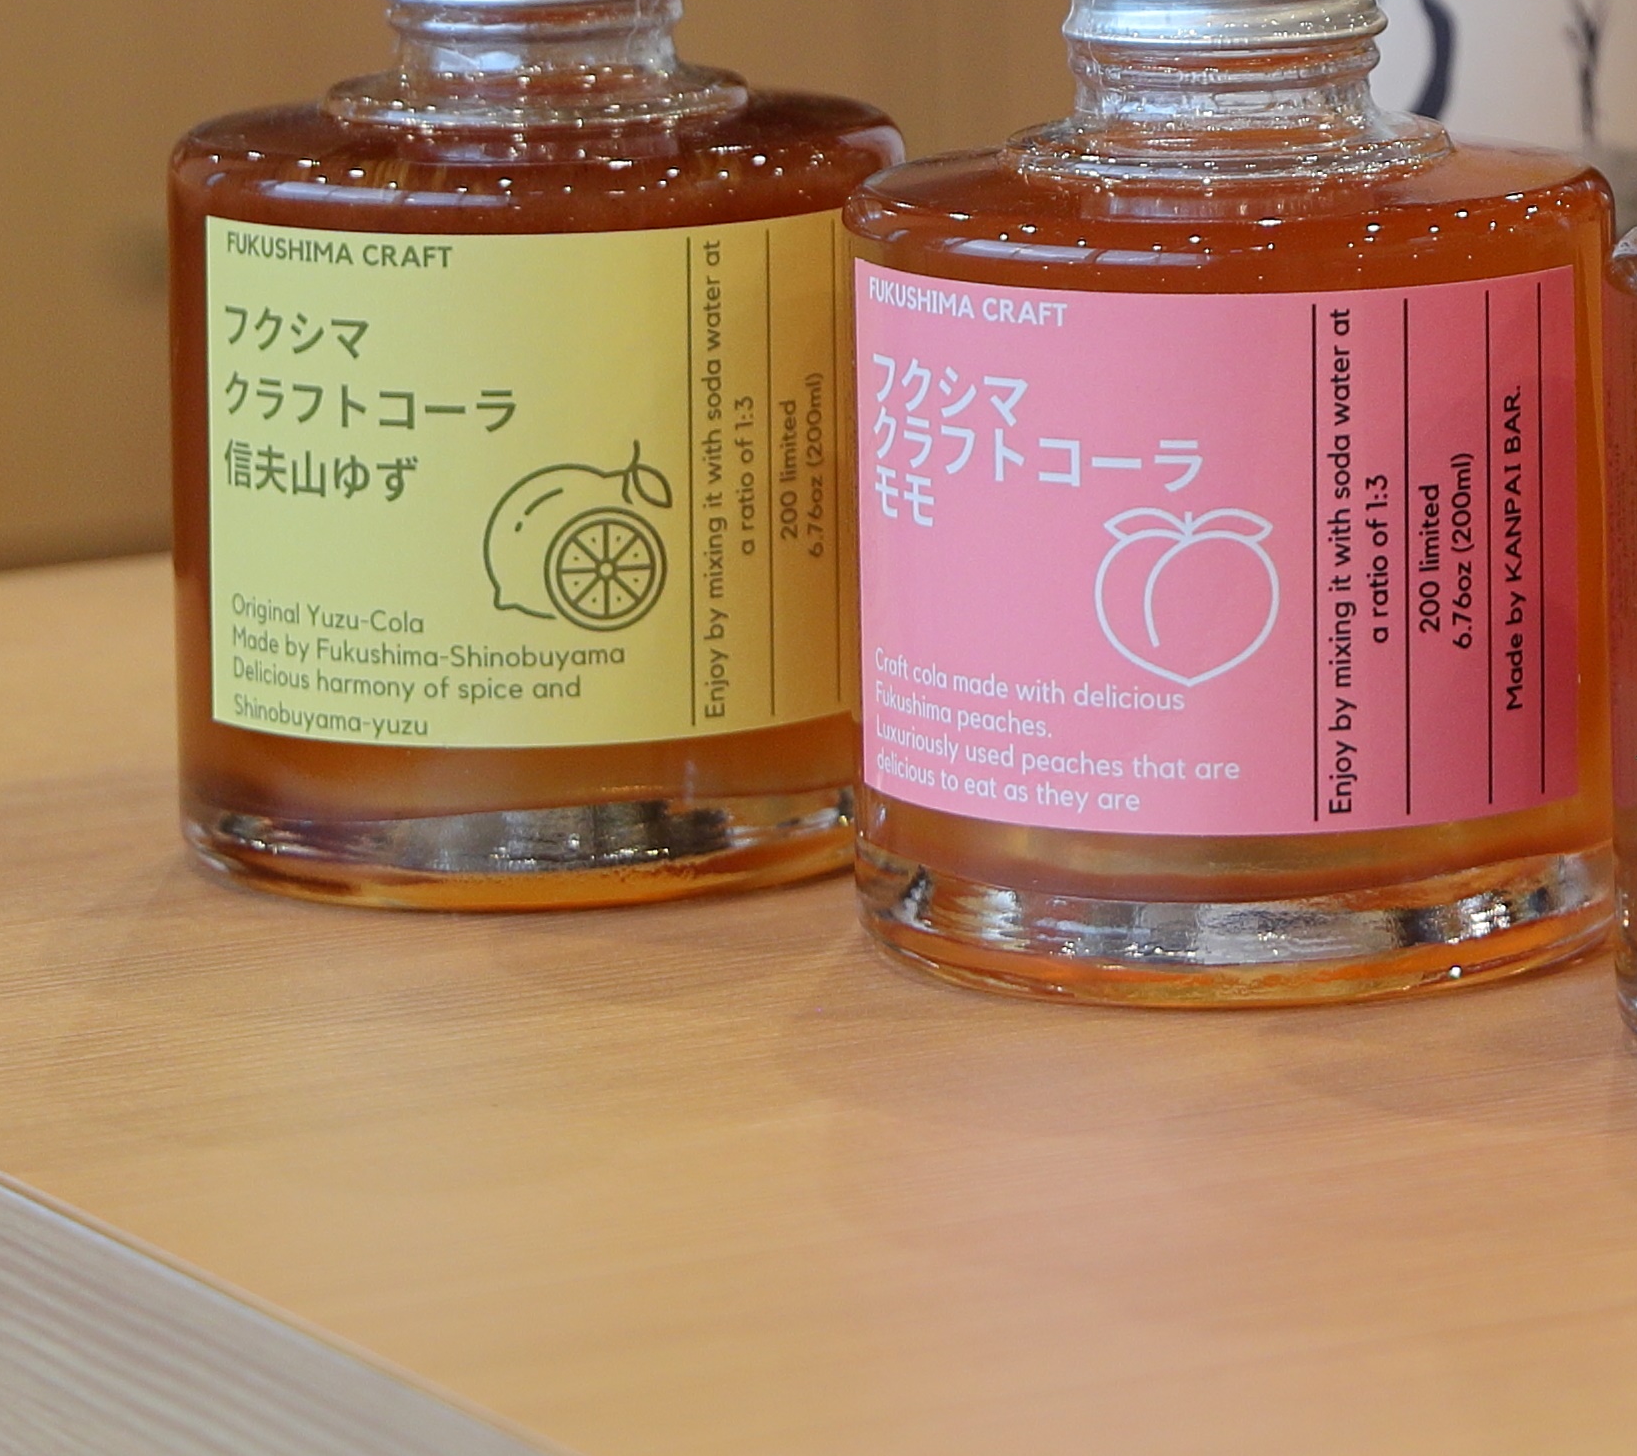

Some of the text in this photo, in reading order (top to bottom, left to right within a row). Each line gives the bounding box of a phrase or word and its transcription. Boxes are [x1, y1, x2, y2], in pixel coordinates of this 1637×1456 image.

[227, 231, 452, 268] FUKUSHIMA CRAFT
[225, 305, 369, 359] フクシマ
[869, 276, 1068, 327] FUKUSHIMA CRAFT
[225, 371, 516, 432] クラフトコーラ
[873, 353, 1028, 426] フクシマ
[224, 439, 419, 501] 信夫山ゆず
[701, 241, 729, 718] Enjoy by mixing it with soda water at
[735, 396, 755, 555] a ratio of 1:3
[780, 399, 798, 539] 200 limited
[805, 373, 824, 558] 6.76oz (200ml)
[873, 406, 1203, 492] クラフトコーラ
[875, 465, 934, 527] モモ
[1327, 309, 1357, 814] Enjoy by mixing it with soda water at
[1366, 475, 1388, 643] a ratio of 1:3
[1418, 484, 1440, 633] 200 limited
[1451, 453, 1474, 649] 6.76oz (200ml)
[1504, 386, 1526, 710] Made by KANPAI BAR.
[232, 593, 424, 634] Original Yuzu-Cola
[233, 626, 625, 672] Made by Fukushima-Shinobuyama
[234, 656, 581, 706] Delicious harmony of spice and
[875, 647, 1185, 710] Craft cola made with delicious
[234, 693, 428, 739] Shinobuyama-yuzu
[876, 681, 1052, 738] Fukushima peaches.
[876, 714, 1240, 780] Luxuriously used peaches that are
[876, 749, 1140, 813] delicious to eat as they are
